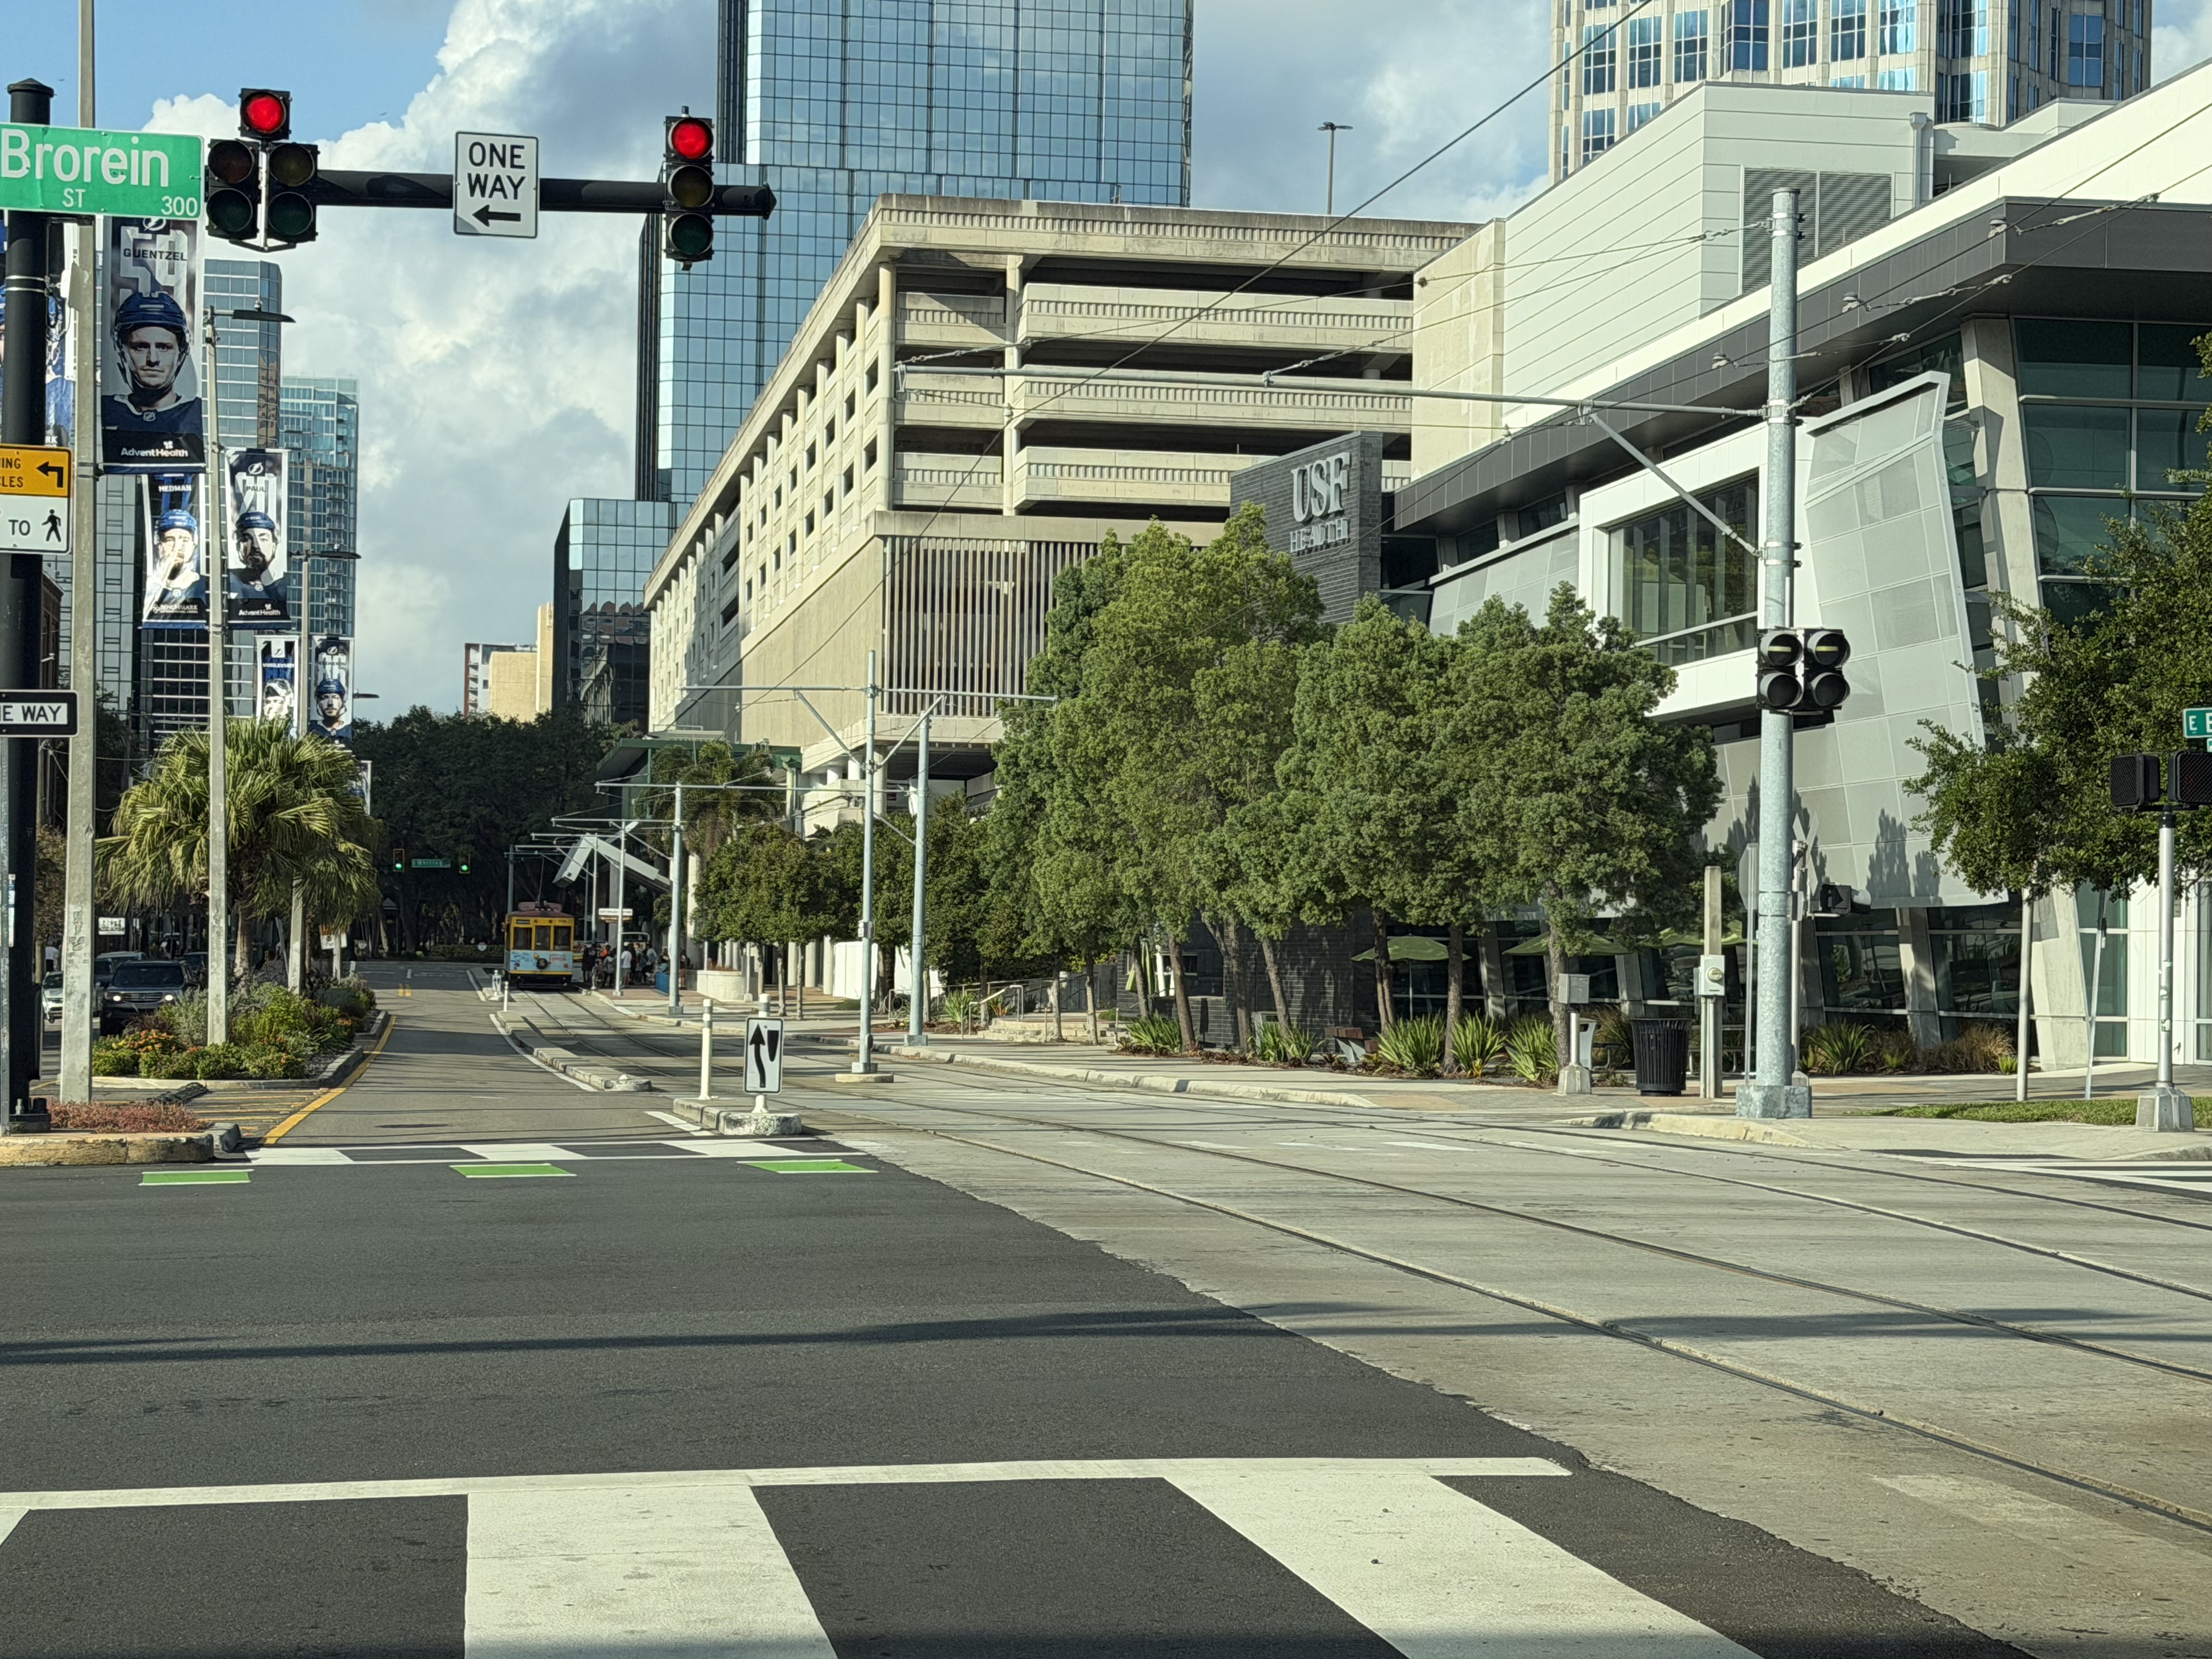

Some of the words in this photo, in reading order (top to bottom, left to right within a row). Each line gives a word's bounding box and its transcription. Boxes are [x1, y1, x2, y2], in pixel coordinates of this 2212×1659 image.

[1, 128, 168, 187] Brorein
[469, 142, 525, 169] ONE
[467, 173, 526, 200] WAY
[63, 188, 86, 208] ST
[161, 195, 198, 216] 300
[123, 248, 188, 261] GUENTZEL
[121, 448, 188, 457] AdventHealth
[1290, 453, 1350, 521] USF
[8, 519, 31, 536] TO
[1290, 518, 1349, 553] HEALTH
[21, 705, 61, 721] WAY
[2189, 715, 2198, 731] E
